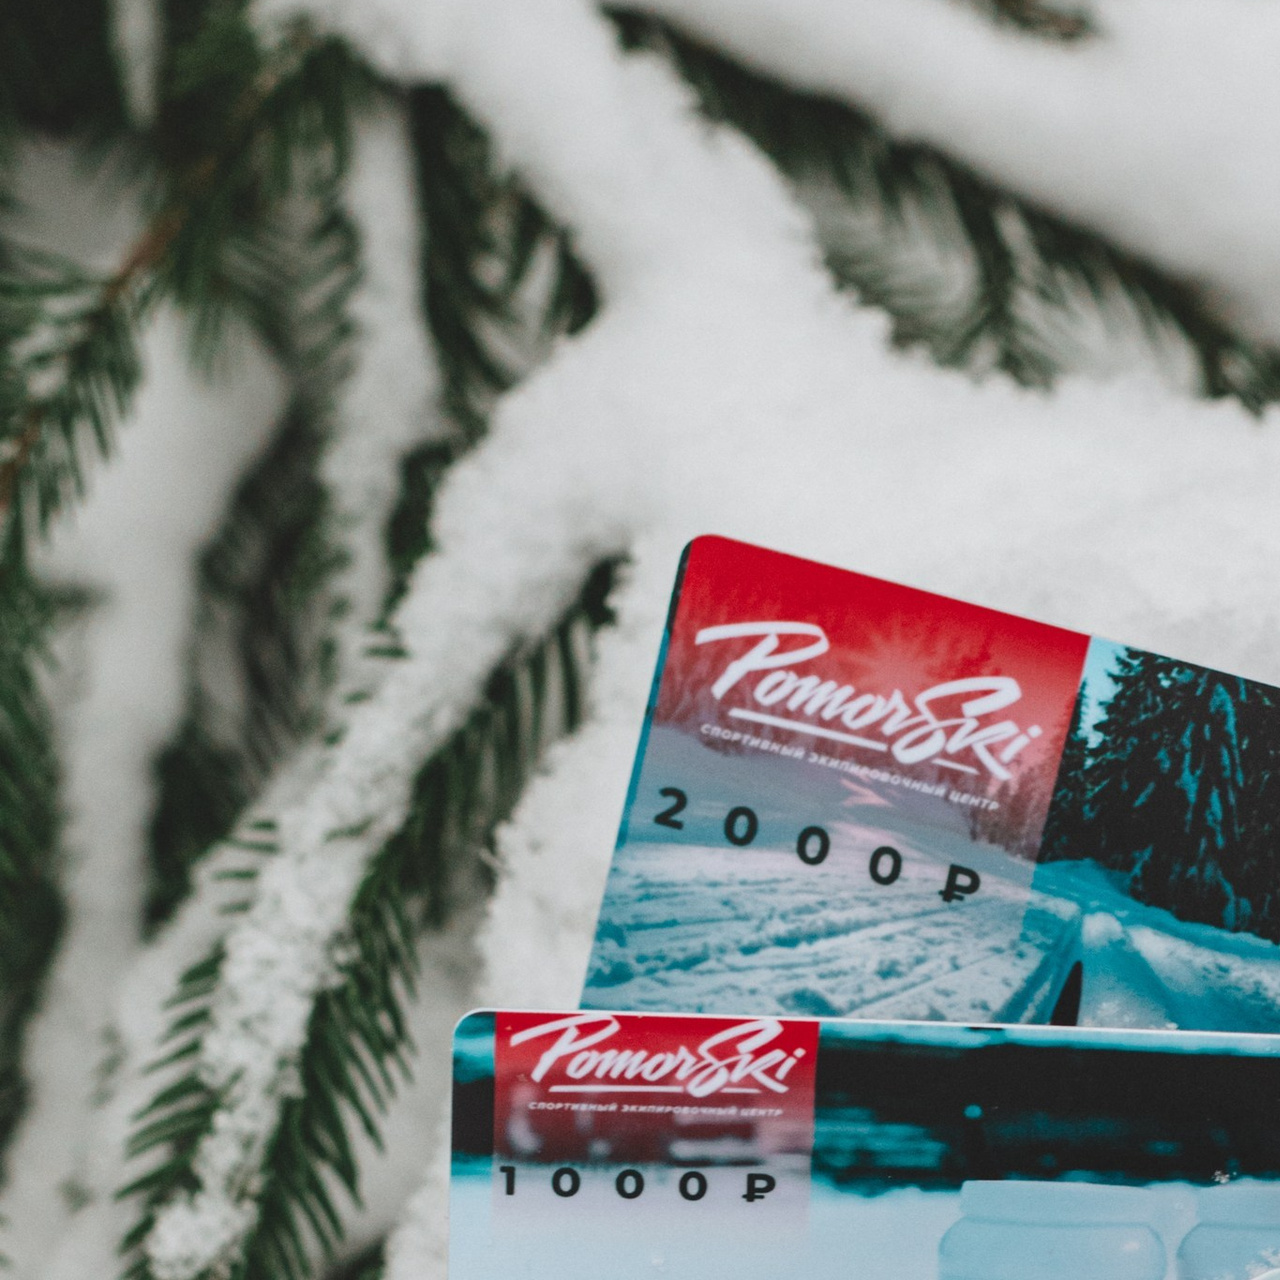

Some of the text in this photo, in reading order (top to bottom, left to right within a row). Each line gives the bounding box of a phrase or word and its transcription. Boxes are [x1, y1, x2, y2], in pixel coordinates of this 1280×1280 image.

[695, 621, 1043, 781] PomorSki
[948, 791, 1001, 812] ЦЕНТР
[510, 1013, 806, 1098] PomorSki
